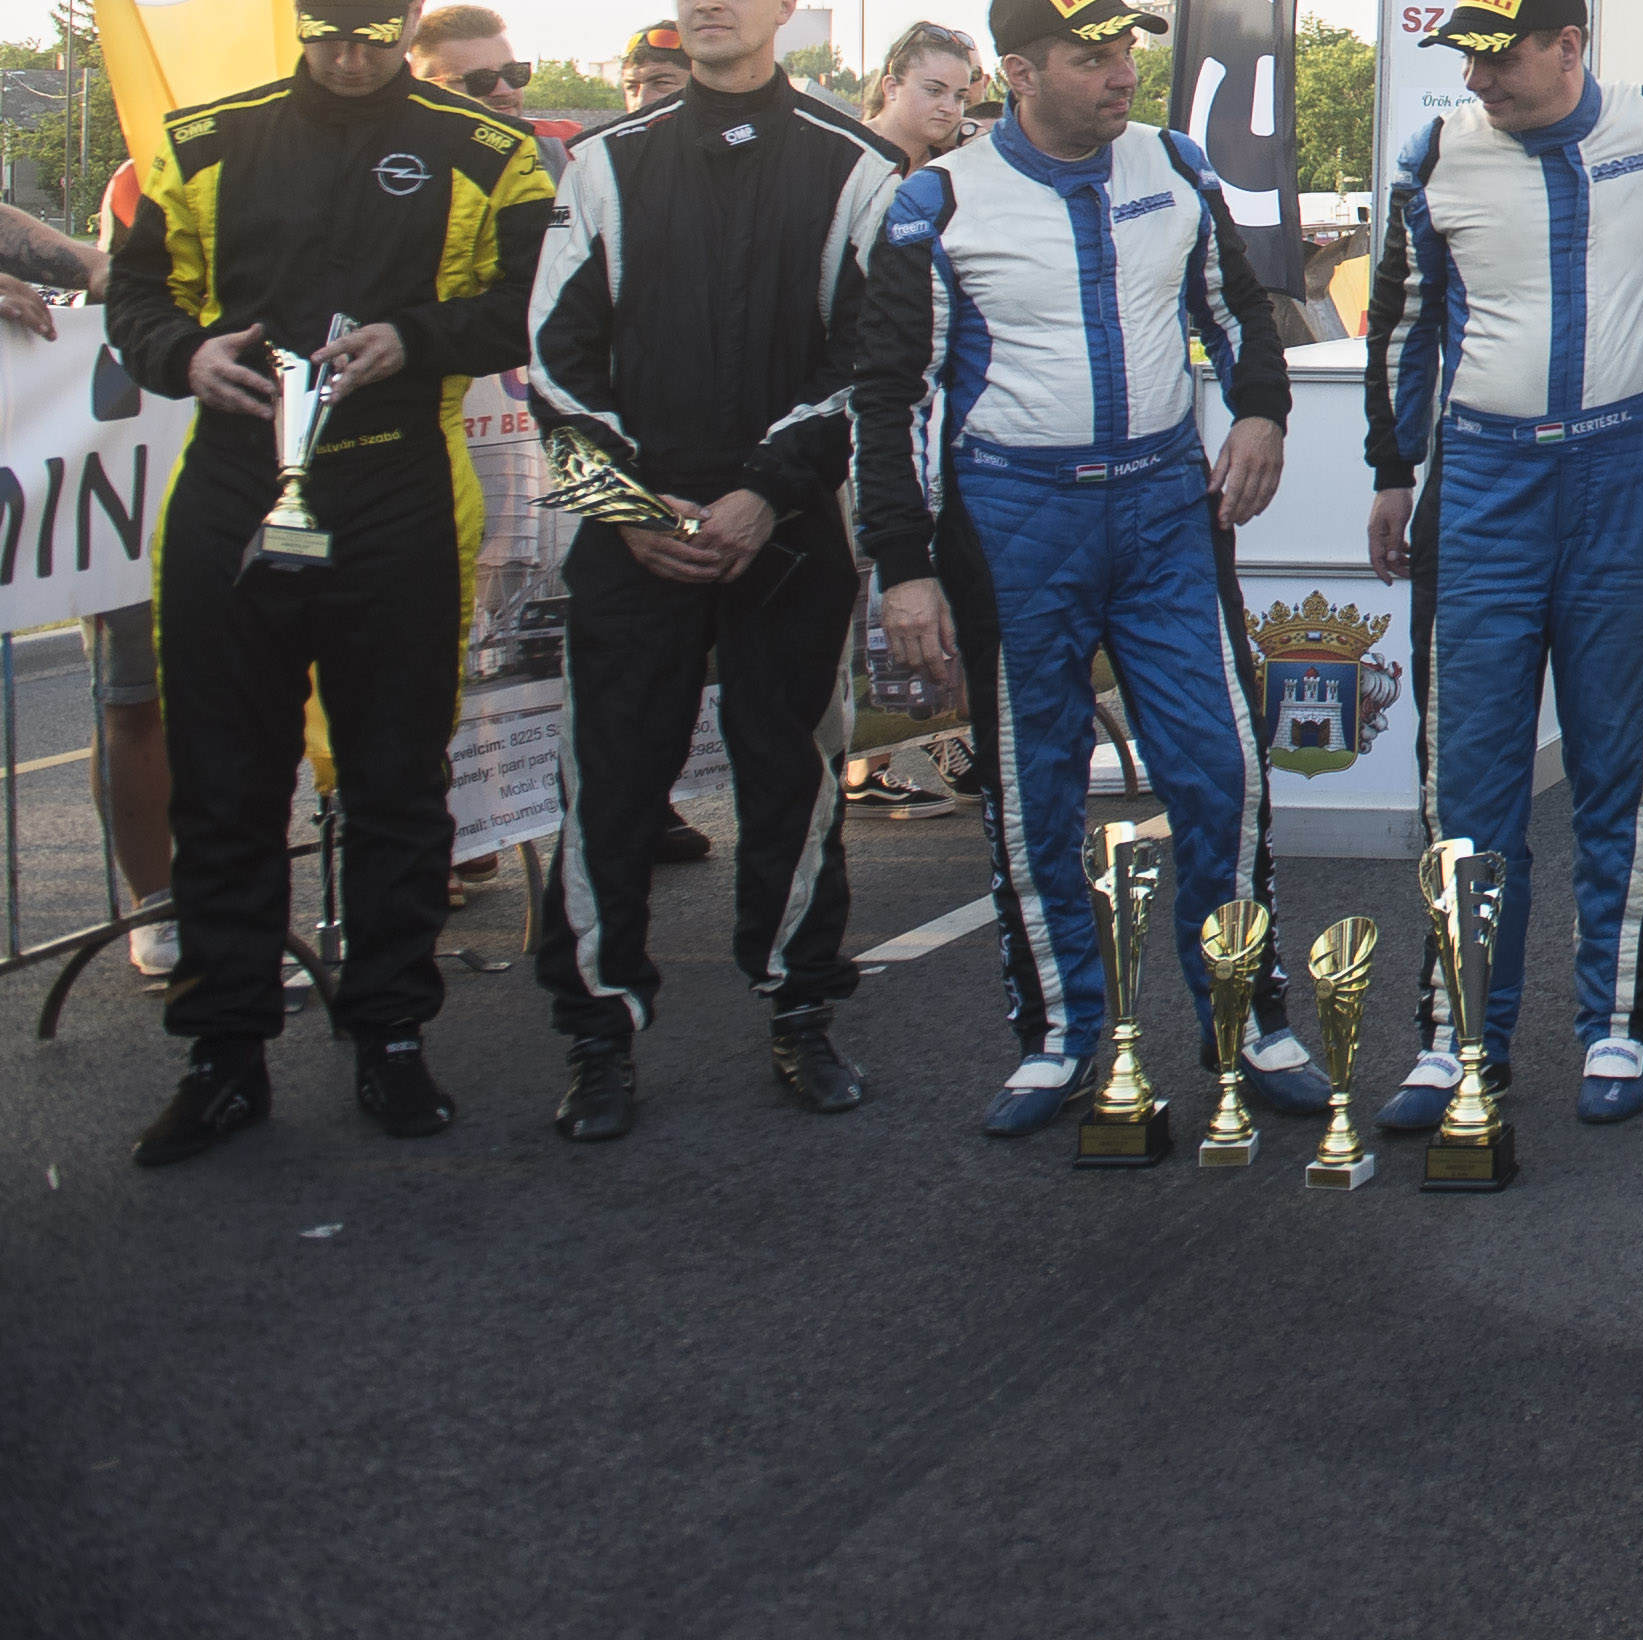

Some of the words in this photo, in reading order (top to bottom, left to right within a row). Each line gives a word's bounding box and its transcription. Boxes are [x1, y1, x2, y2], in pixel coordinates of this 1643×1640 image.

[174, 120, 215, 141] OMP
[474, 127, 513, 150] OMP
[724, 126, 754, 144] OMP
[551, 210, 571, 224] MP
[509, 726, 543, 747] 8225
[500, 776, 539, 800] Mobil:
